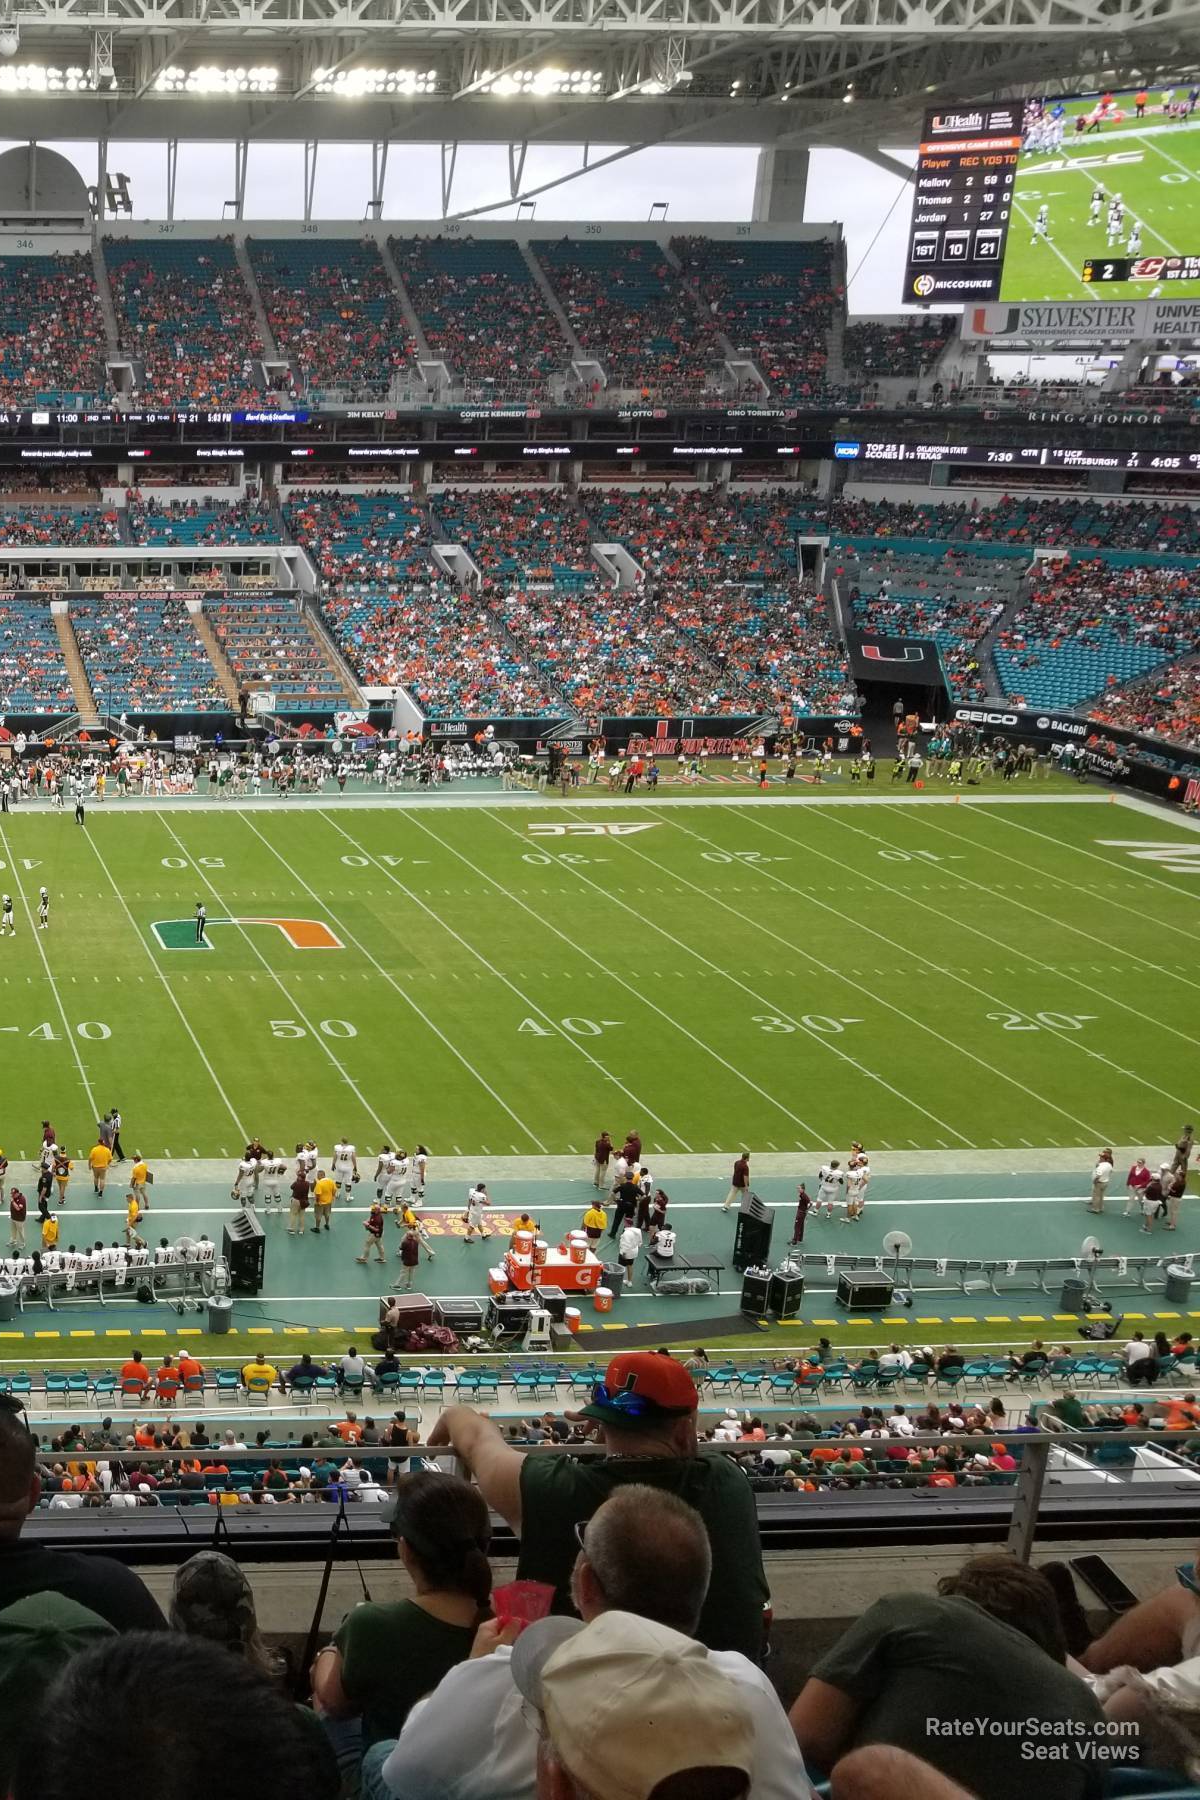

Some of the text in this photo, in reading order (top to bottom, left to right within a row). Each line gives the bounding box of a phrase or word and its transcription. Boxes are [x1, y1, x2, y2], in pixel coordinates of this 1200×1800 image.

[922, 155, 1018, 169] Player REC YDS TD
[966, 177, 974, 186] 2
[1005, 175, 1012, 184] 0
[964, 195, 972, 204] 2
[982, 194, 994, 202] 10
[1002, 193, 1010, 202] 0
[915, 210, 1008, 222] Jordan 1 27 0
[158, 225, 174, 233] 347
[585, 226, 602, 234] 350
[17, 240, 34, 248] 346
[916, 243, 995, 256] 1ST 10 21
[1102, 265, 1114, 279] 2
[935, 280, 992, 288] MICCOSUKEE
[1022, 306, 1136, 328] SYLVESTER
[56, 414, 78, 422] 11:00
[146, 414, 155, 422] 10
[190, 414, 198, 422] 21
[1028, 413, 1162, 424] RING HONOR
[866, 444, 884, 452] TOP
[916, 452, 1012, 462] TEXAS 7:30
[1064, 458, 1180, 468] PITTSBURGH 21 4:05
[956, 709, 1018, 726] GEICO
[752, 1014, 844, 1032] 30
[986, 1010, 1082, 1030] 20
[28, 1020, 112, 1040] 40
[269, 1018, 358, 1038] 50
[518, 1017, 602, 1036] 40
[575, 1269, 592, 1285] G
